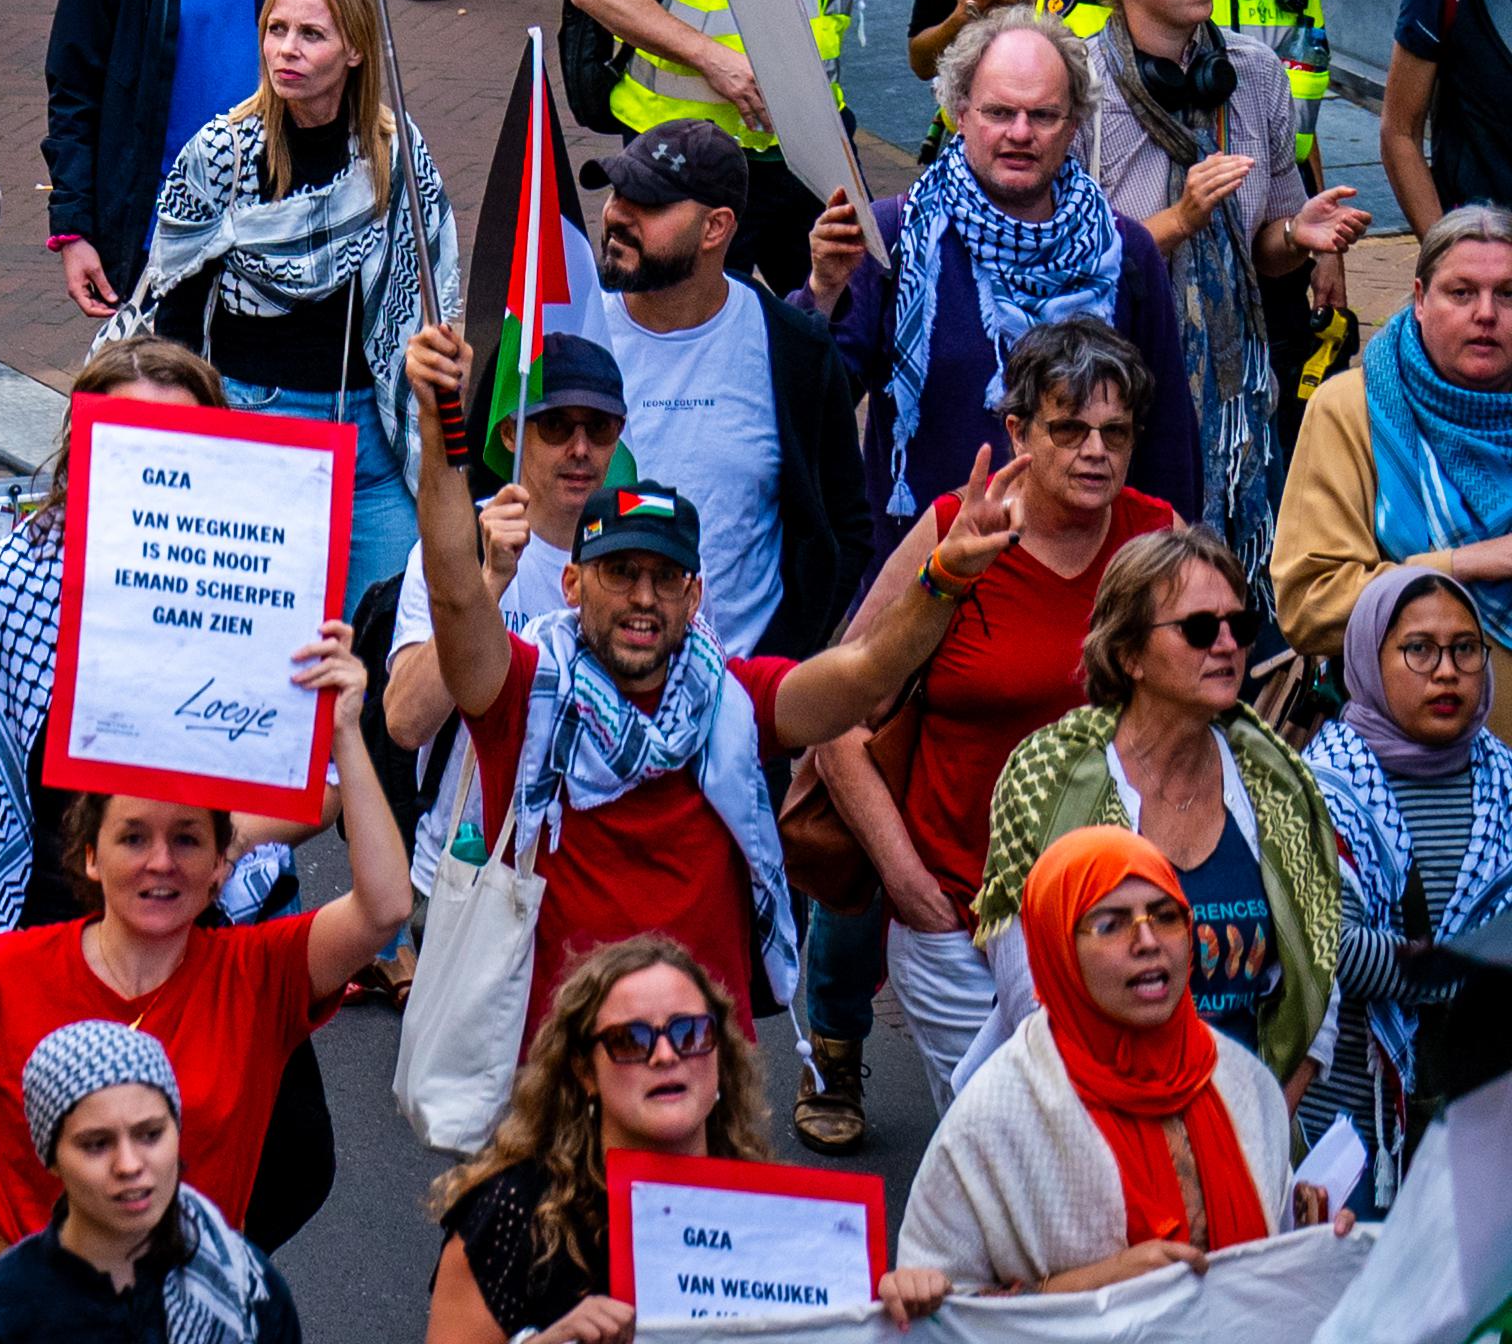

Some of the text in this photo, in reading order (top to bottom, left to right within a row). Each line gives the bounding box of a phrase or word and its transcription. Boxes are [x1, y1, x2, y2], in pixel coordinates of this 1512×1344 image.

[643, 398, 715, 408] ICONO COUTURE
[142, 466, 192, 491] GAZA
[132, 509, 285, 546] VAN WEGKIJKEN
[141, 540, 272, 574] IS NOG NOOIT
[114, 568, 296, 610] IEMAND SCHERPER
[152, 604, 254, 636] GAAN ZIEN
[173, 675, 278, 730] Loesje
[1195, 900, 1268, 922] RENCES
[683, 1225, 734, 1251] GAZA
[677, 1273, 829, 1307] VAN WEGKIJKEN
